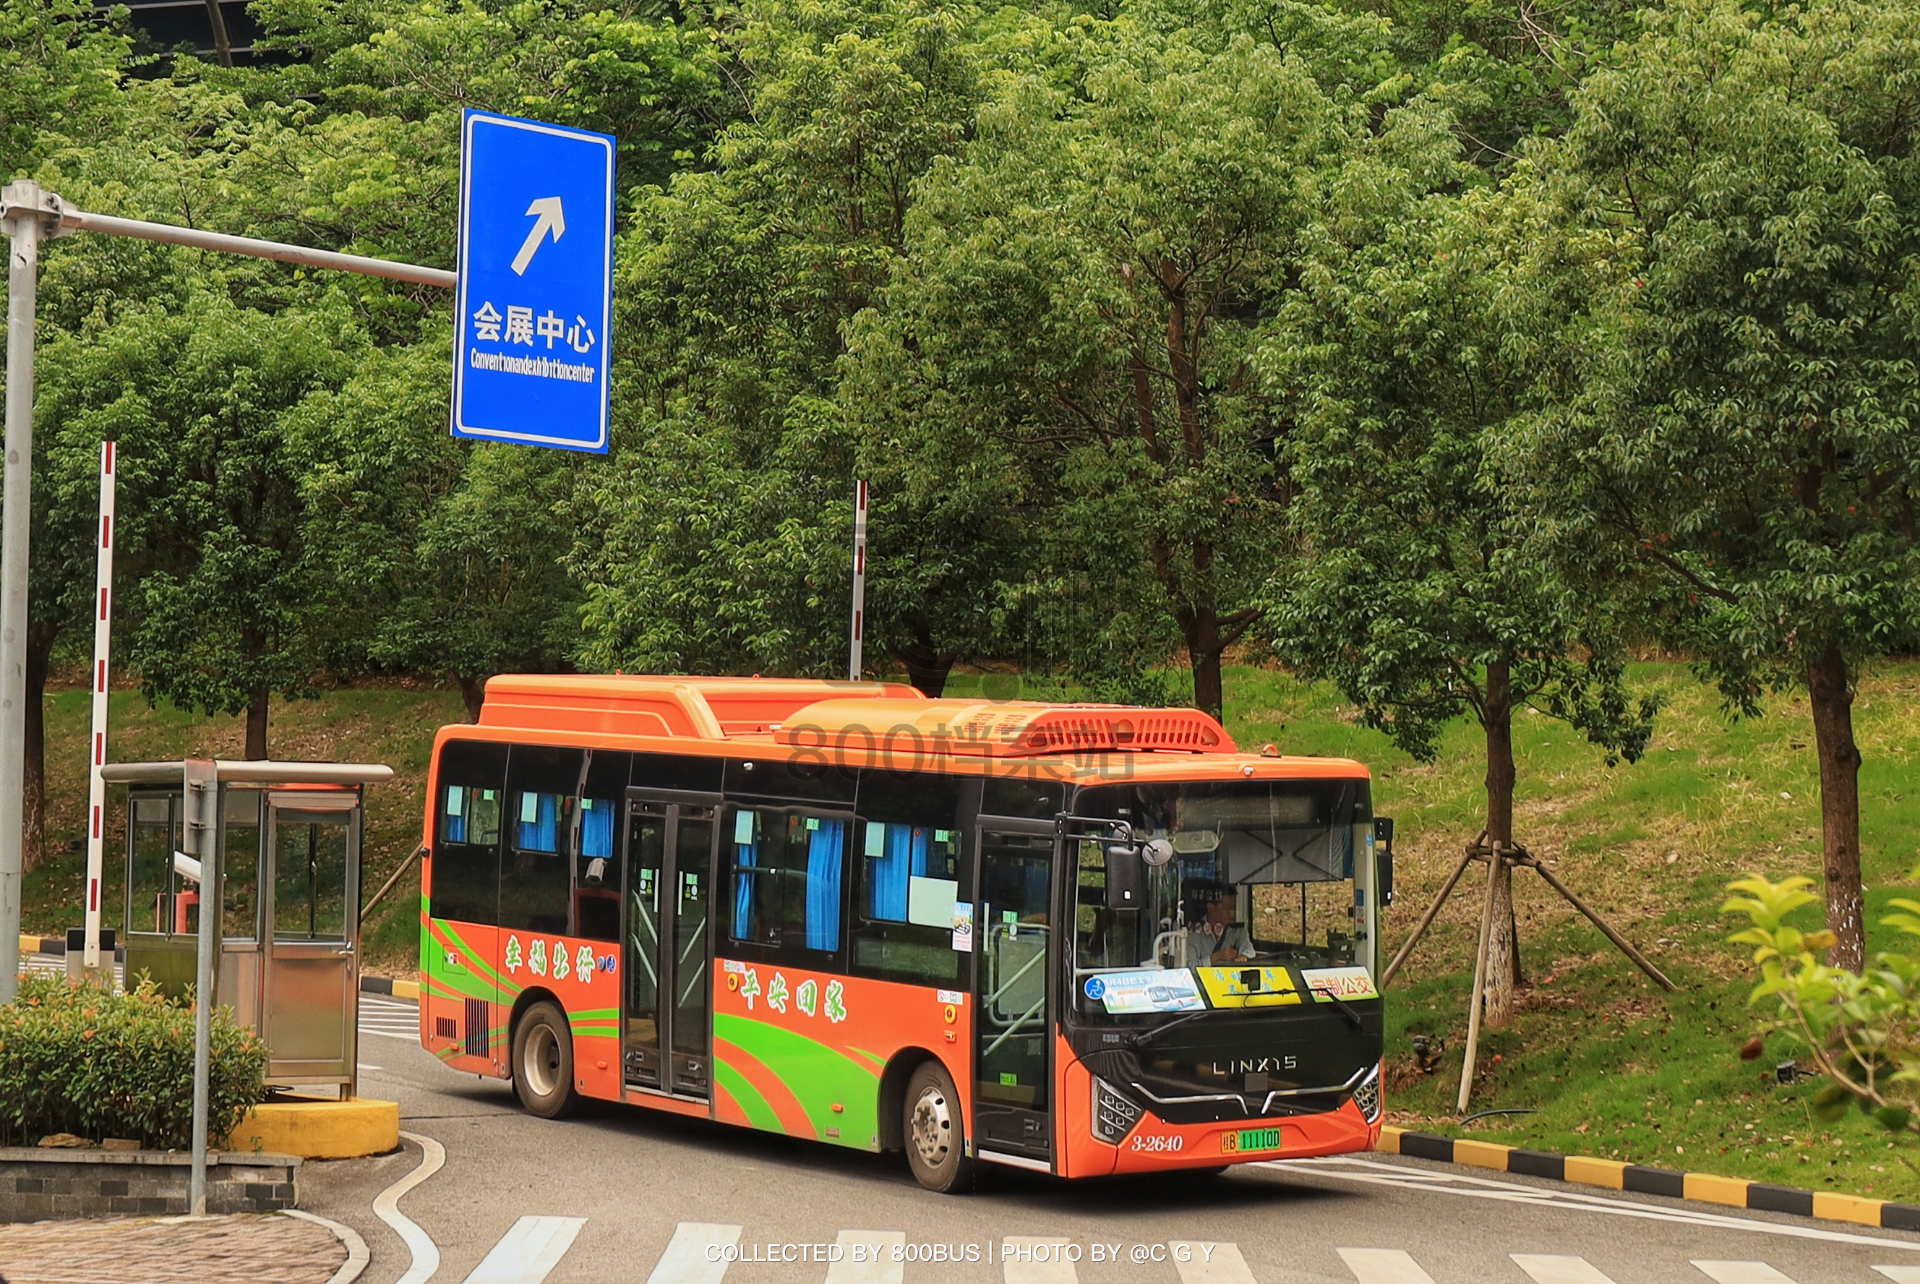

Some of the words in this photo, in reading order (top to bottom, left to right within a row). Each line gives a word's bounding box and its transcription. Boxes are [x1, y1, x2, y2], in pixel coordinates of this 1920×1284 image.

[472, 301, 596, 354] 会展中心
[505, 934, 596, 985] 幸福出行
[740, 968, 848, 1024] 平安回家
[1310, 975, 1374, 997] 定制公交
[1131, 1135, 1183, 1152] 3-2640
